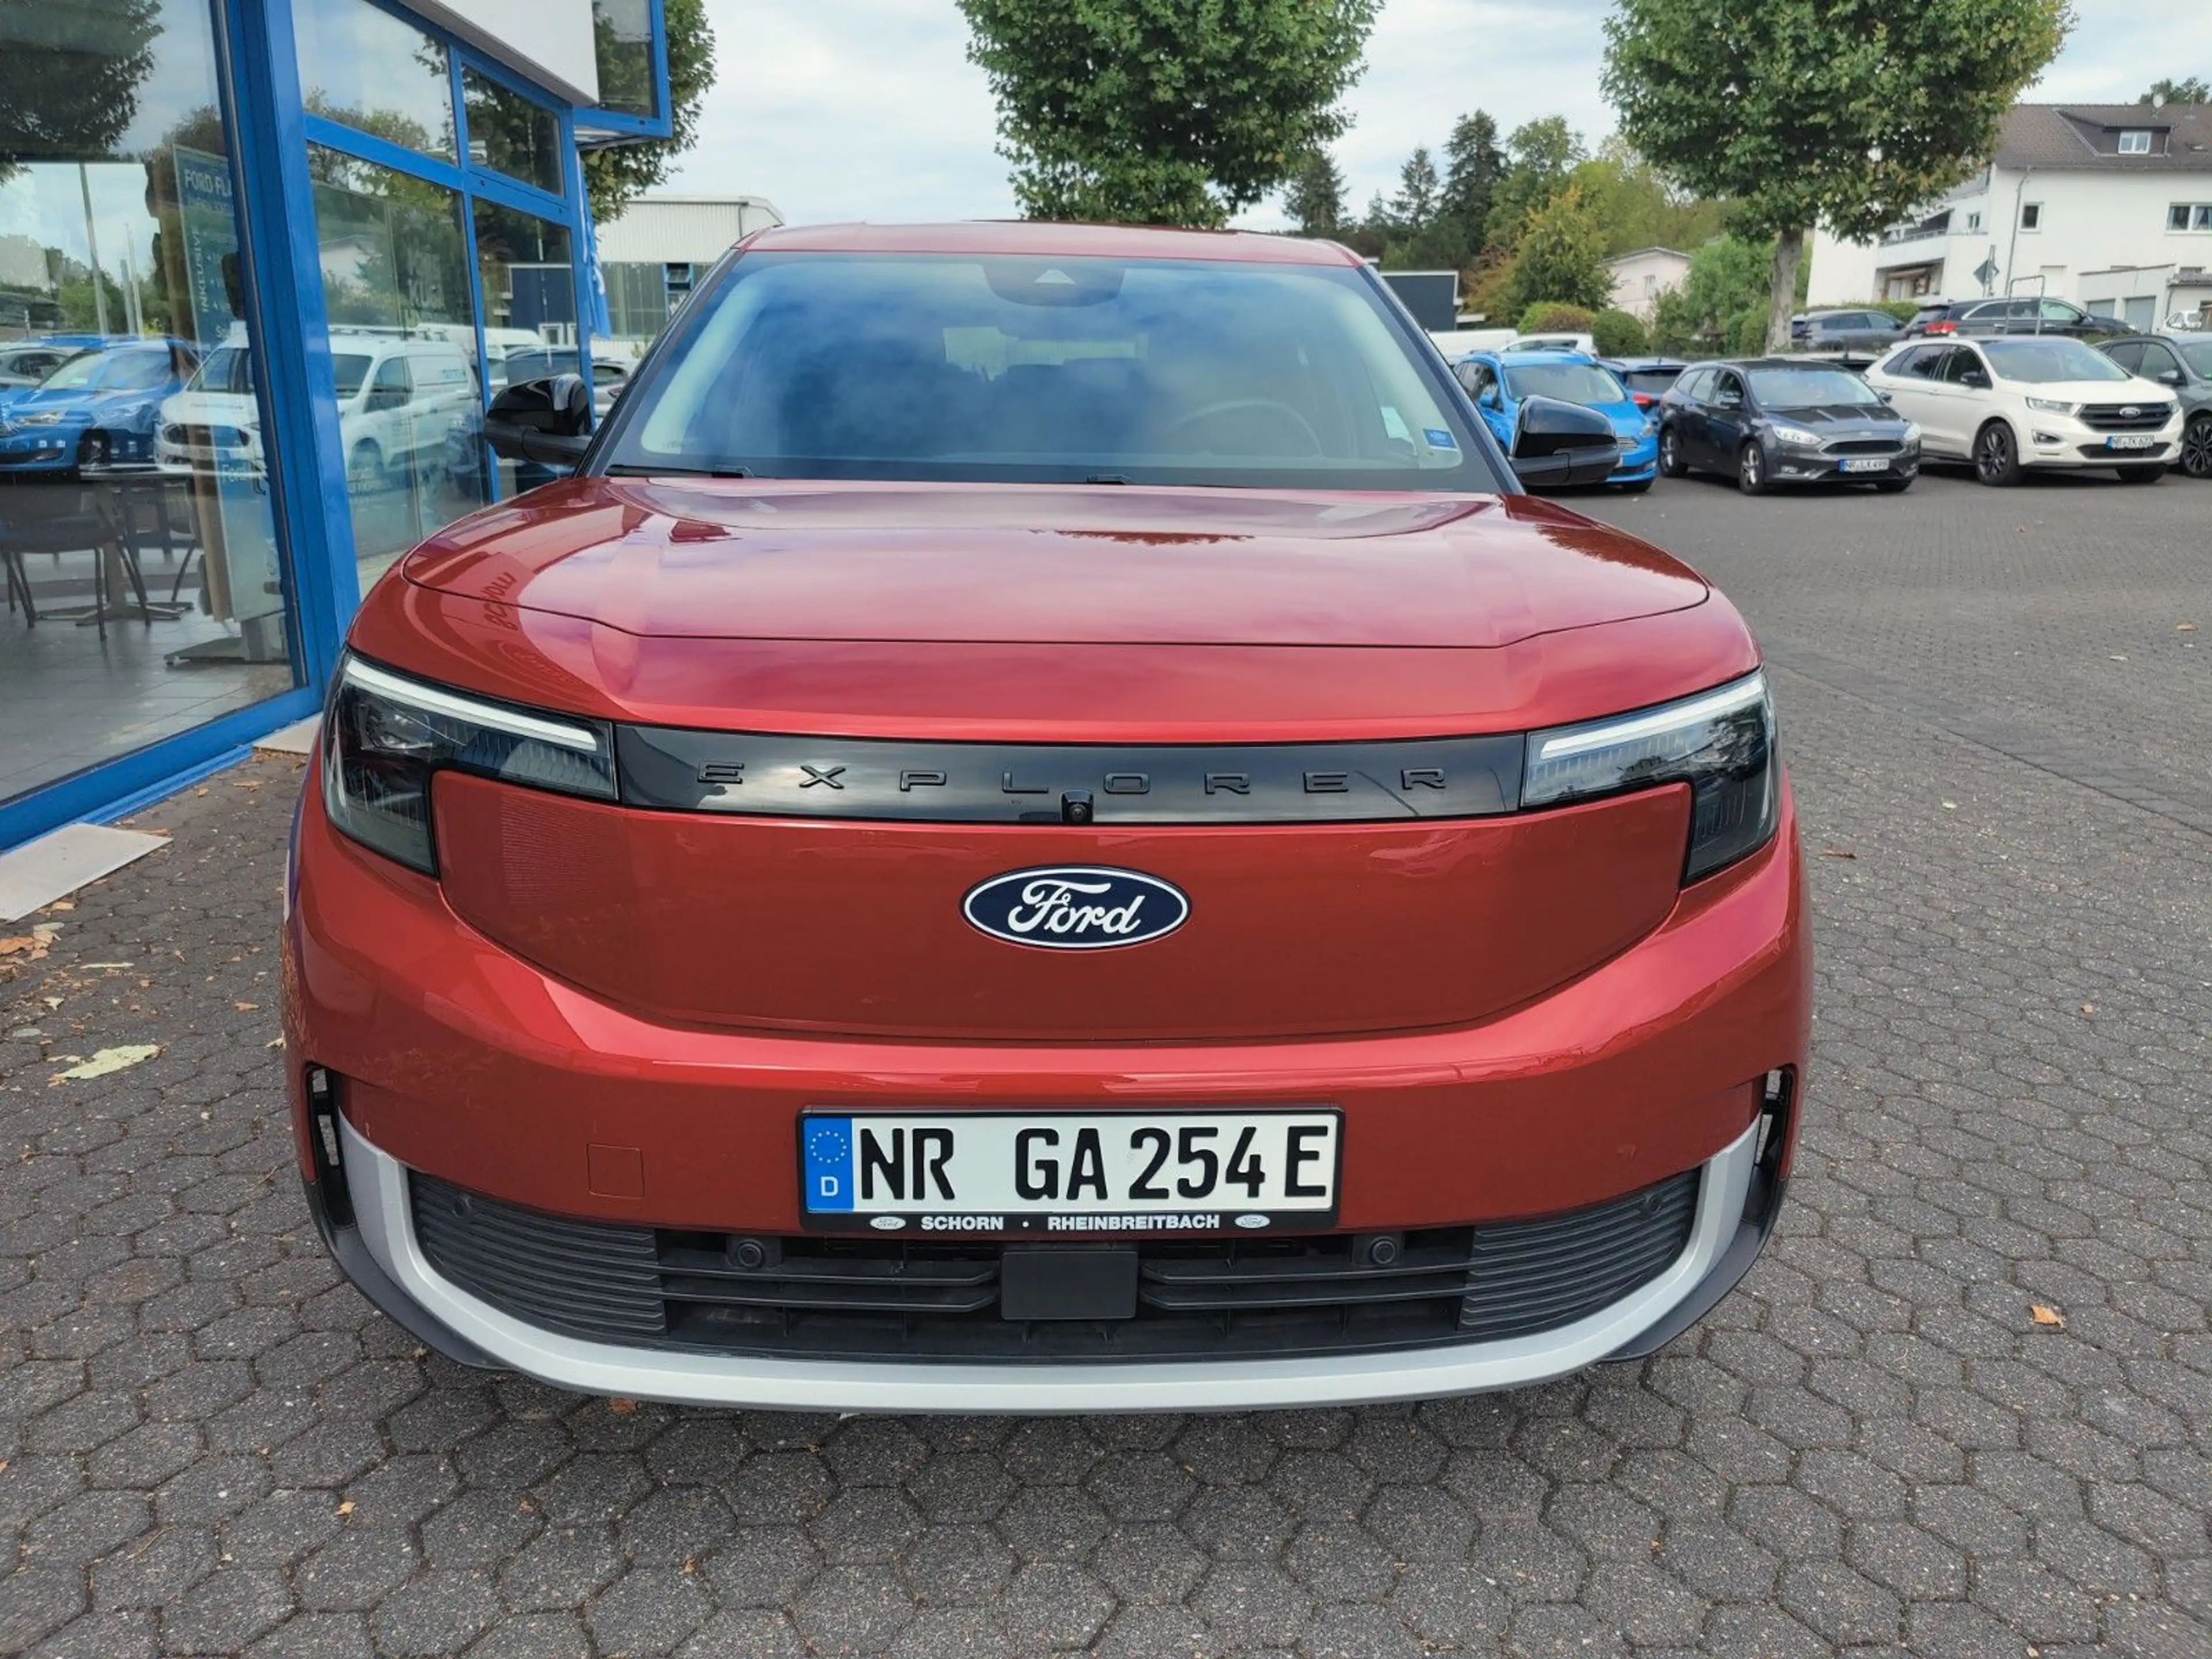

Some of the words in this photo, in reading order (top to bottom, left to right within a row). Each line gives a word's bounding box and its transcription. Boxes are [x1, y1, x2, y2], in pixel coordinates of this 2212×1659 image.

[697, 760, 1446, 795] EXPLORER
[1007, 878, 1146, 934] Ford
[860, 1127, 955, 1200] NR
[1015, 1127, 1108, 1200] GA
[820, 1176, 839, 1197] D
[921, 1215, 1004, 1230] SCHORN
[1047, 1214, 1220, 1230] RHEINBREITBACH
